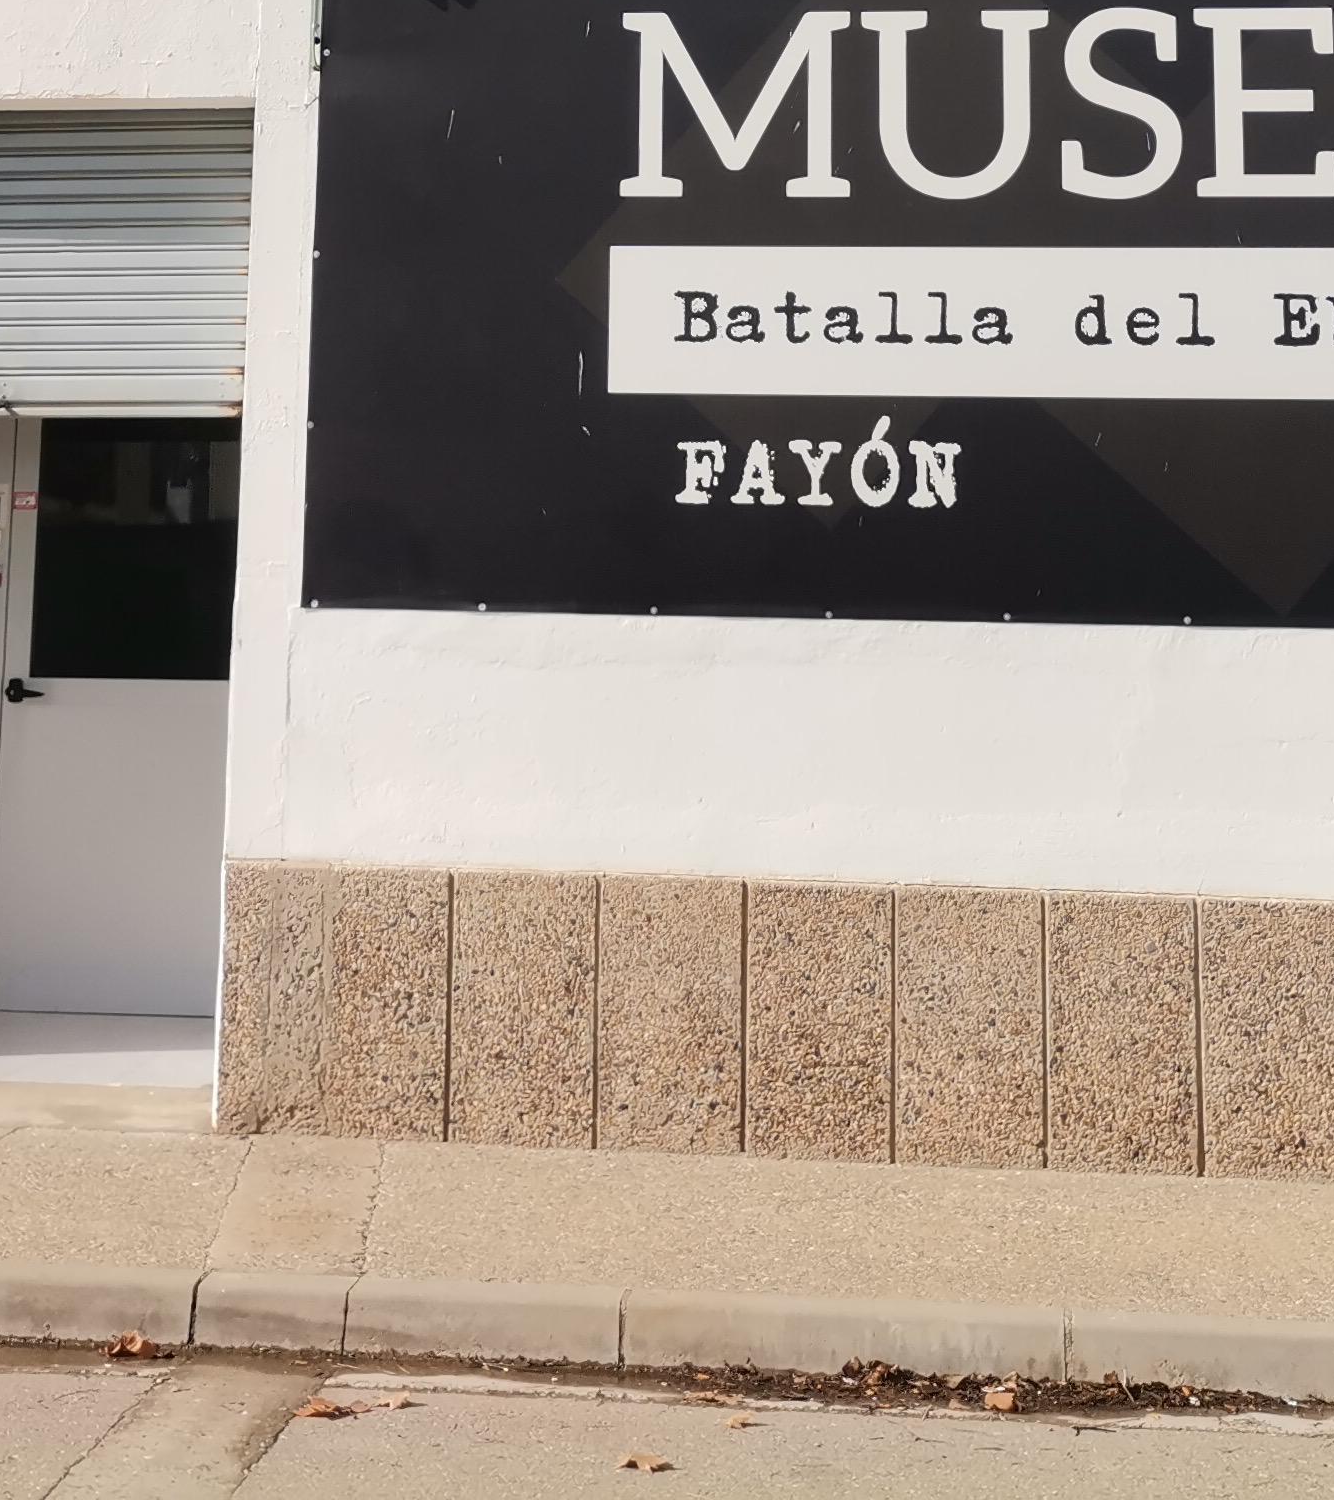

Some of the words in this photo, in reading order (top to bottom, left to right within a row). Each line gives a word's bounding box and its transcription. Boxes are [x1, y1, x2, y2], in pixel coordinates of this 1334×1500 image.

[673, 289, 1015, 348] Batalla
[1073, 291, 1217, 349] del
[673, 414, 964, 510] FAYÓN
